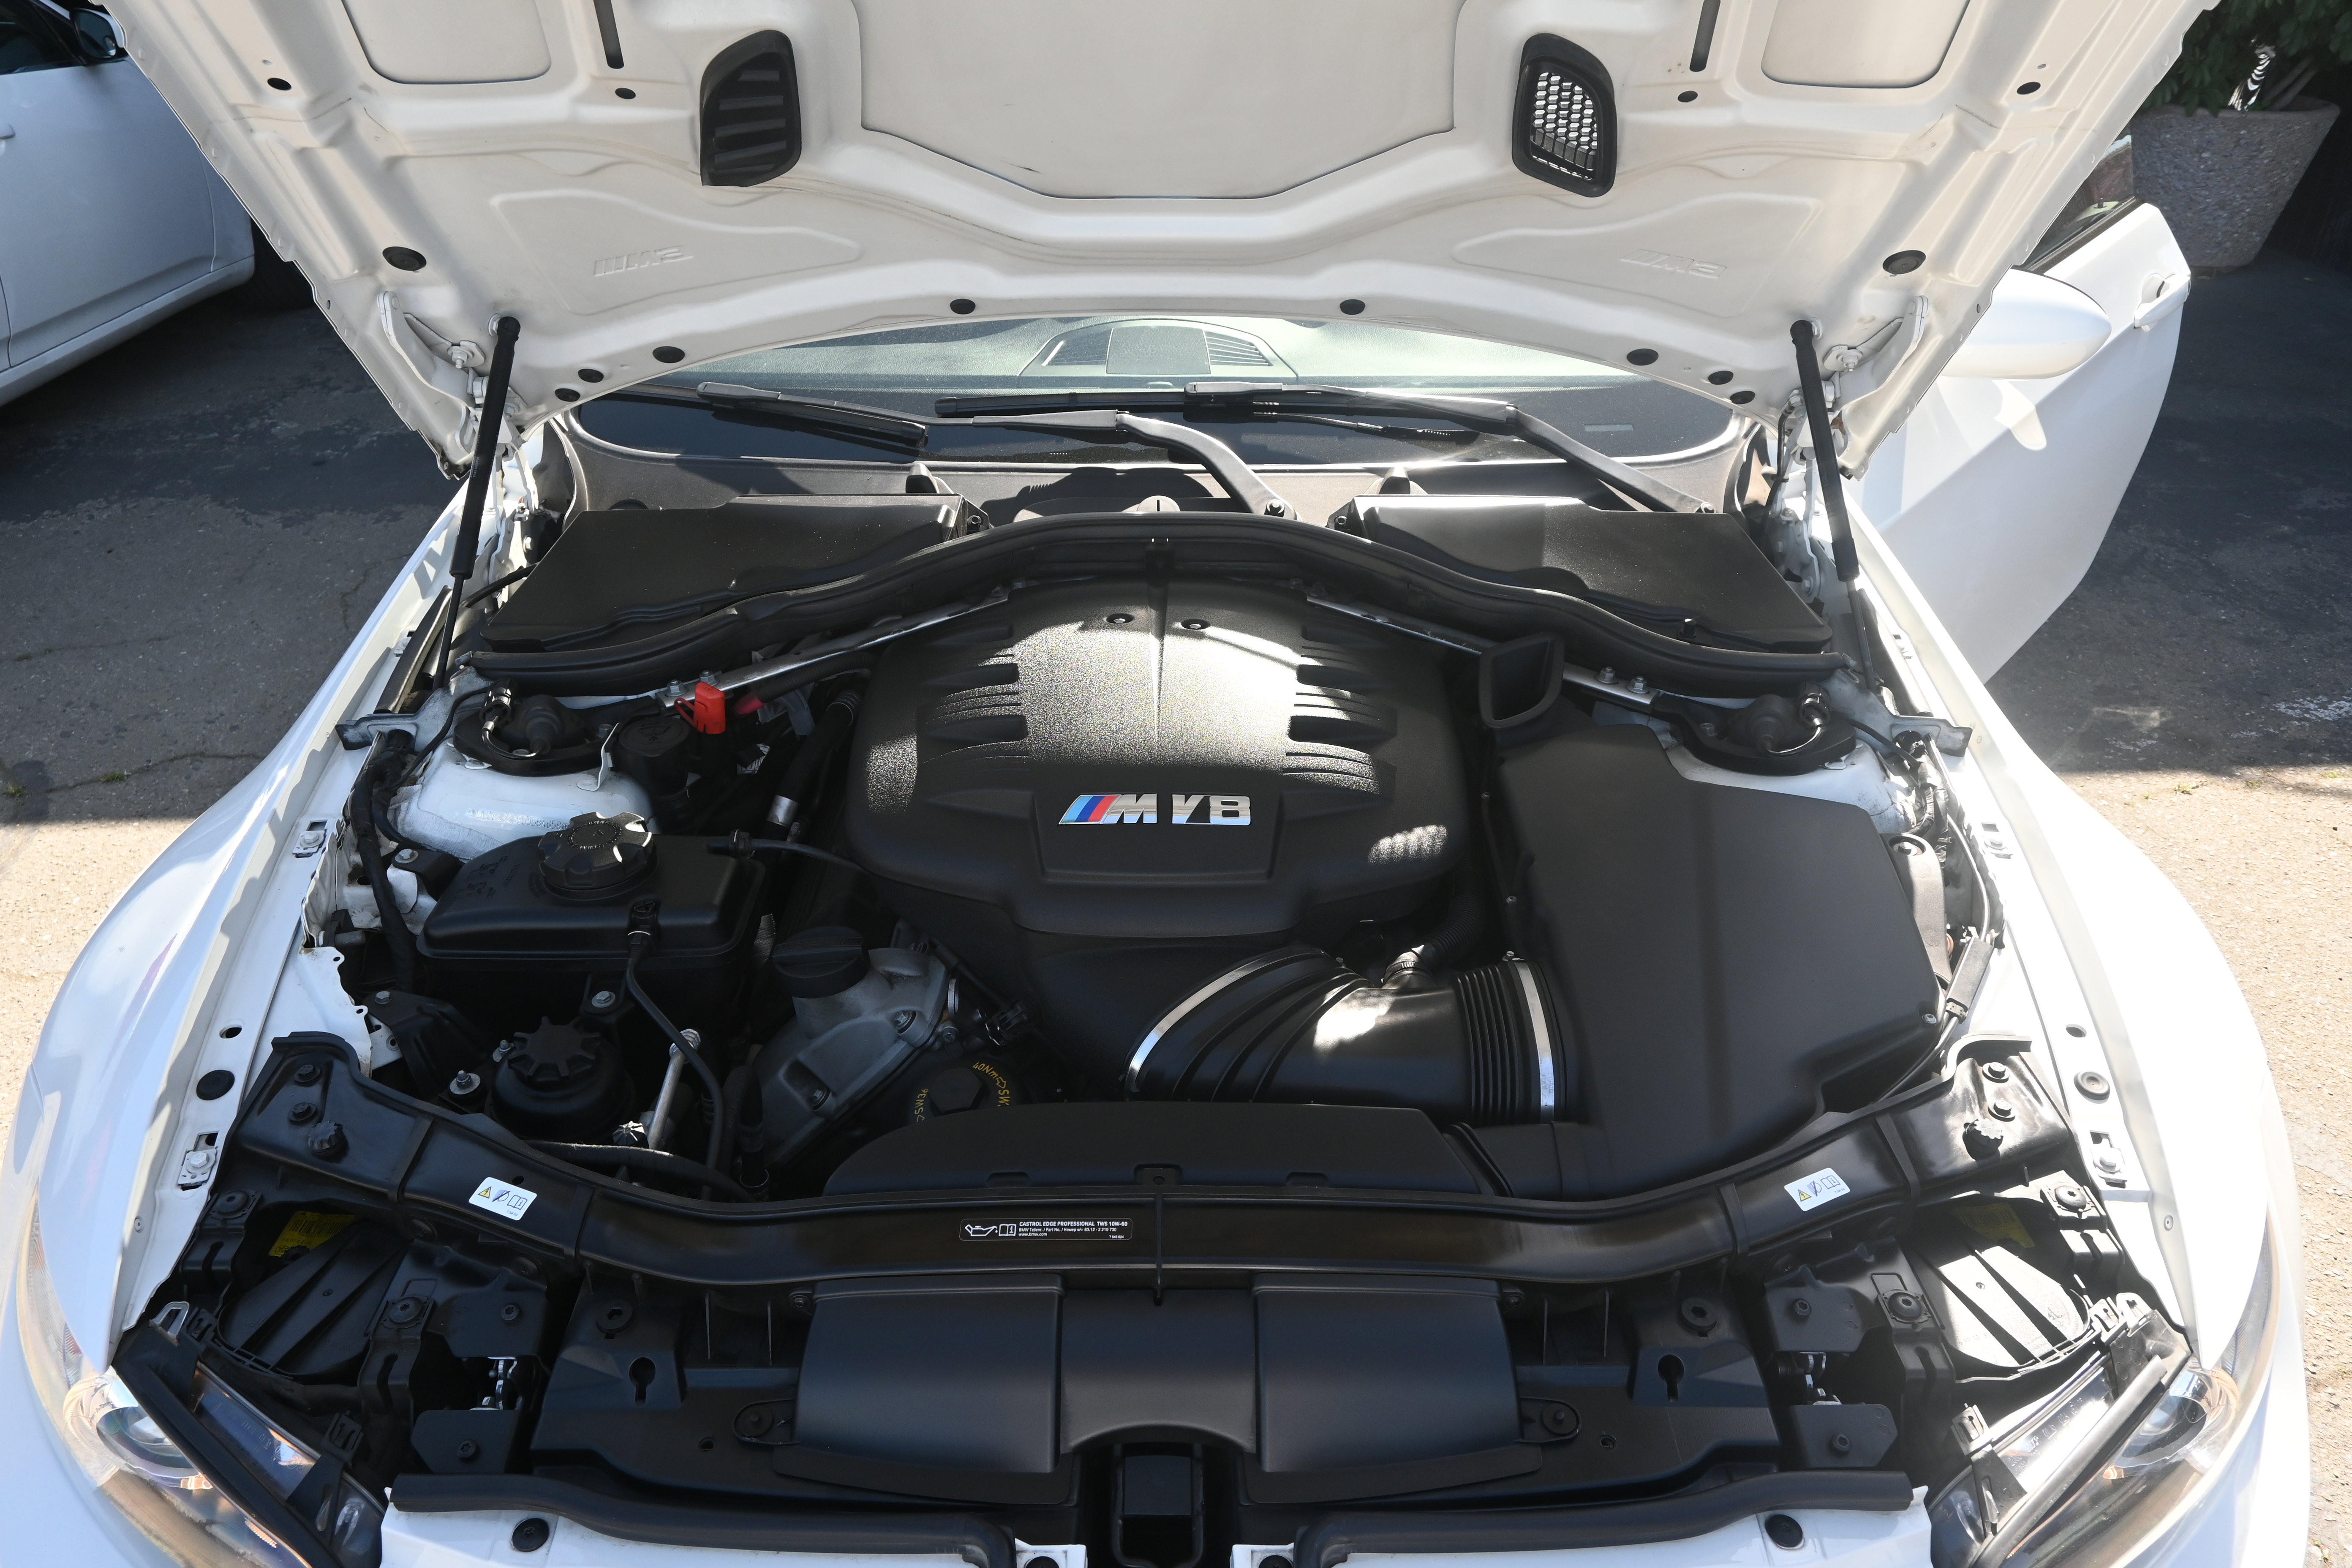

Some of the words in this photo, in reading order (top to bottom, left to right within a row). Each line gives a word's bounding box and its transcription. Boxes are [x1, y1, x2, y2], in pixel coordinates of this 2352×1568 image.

[1172, 794, 1251, 826] V8
[972, 1062, 999, 1079] 40Nm
[914, 1088, 929, 1115] SW36
